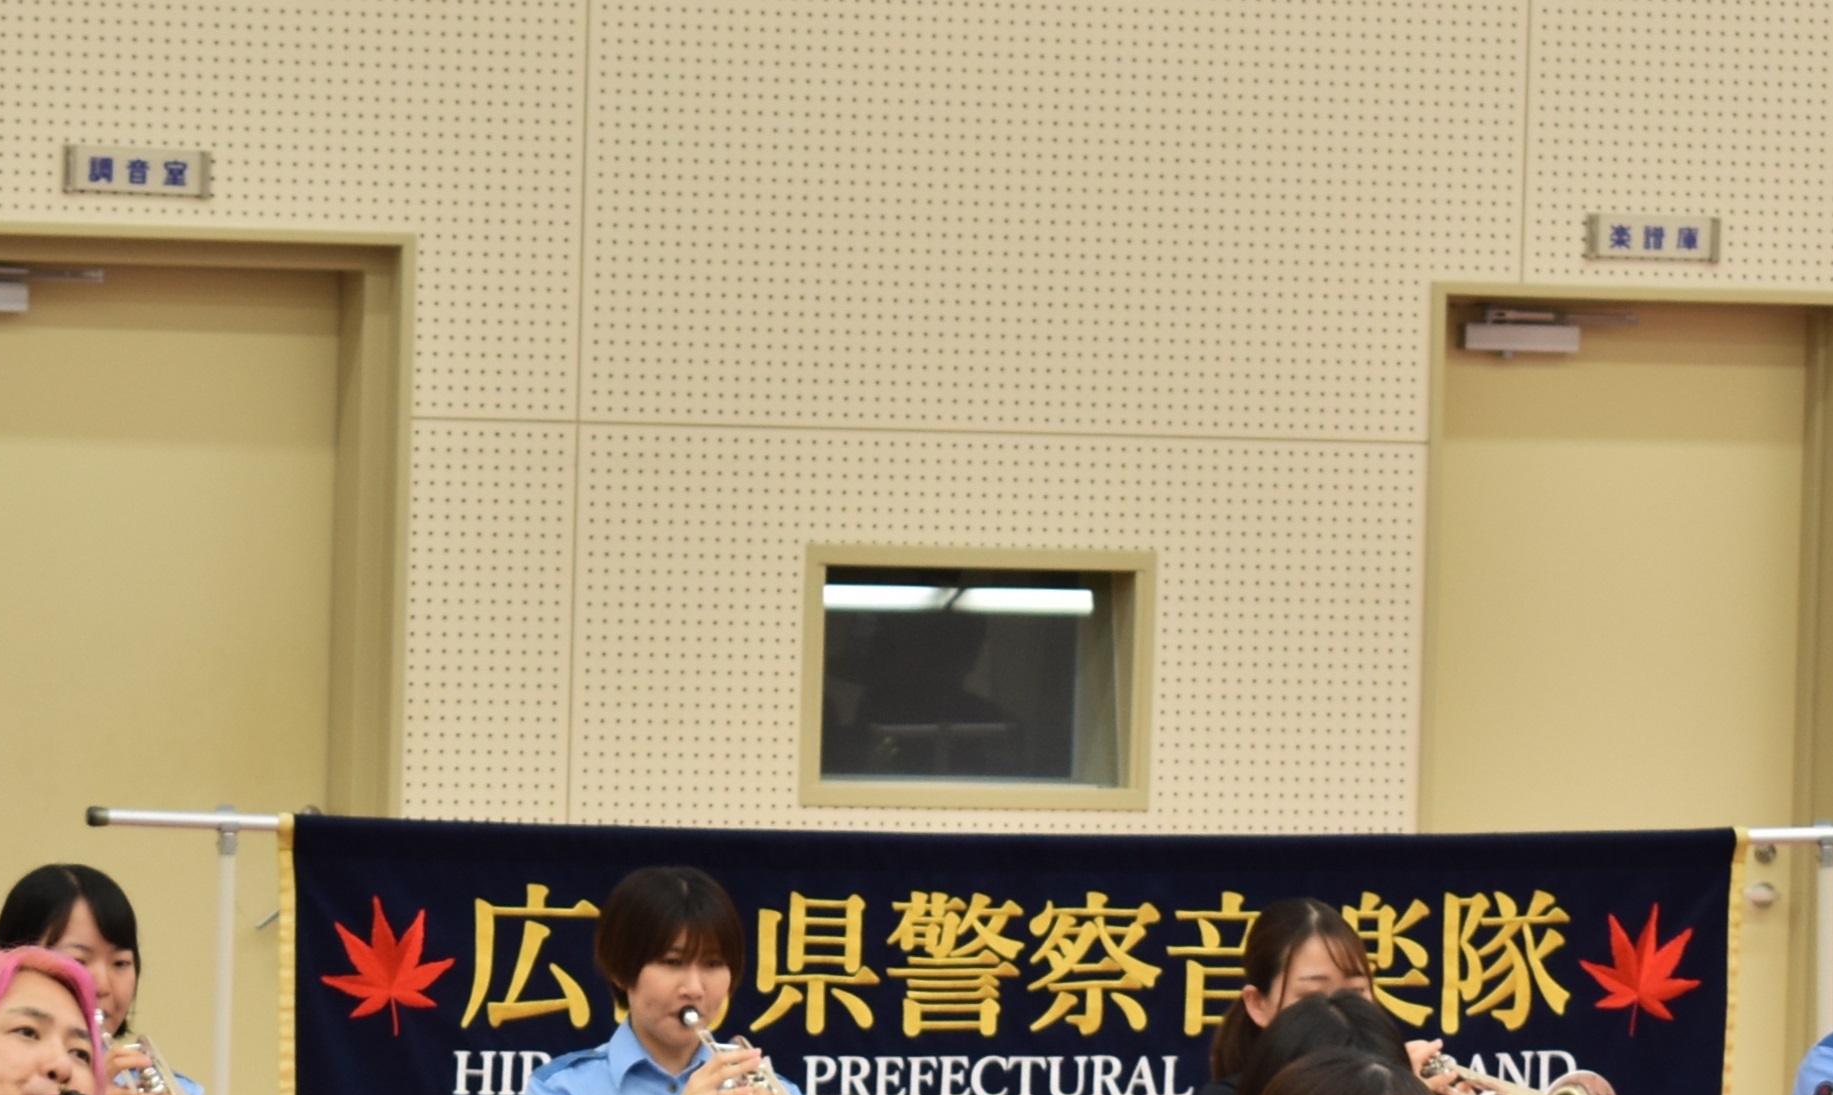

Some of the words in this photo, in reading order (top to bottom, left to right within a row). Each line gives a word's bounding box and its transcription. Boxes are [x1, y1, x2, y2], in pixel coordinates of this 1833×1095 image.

[88, 156, 188, 187] 調音室
[460, 882, 1572, 1038] 広県警察音楽隊
